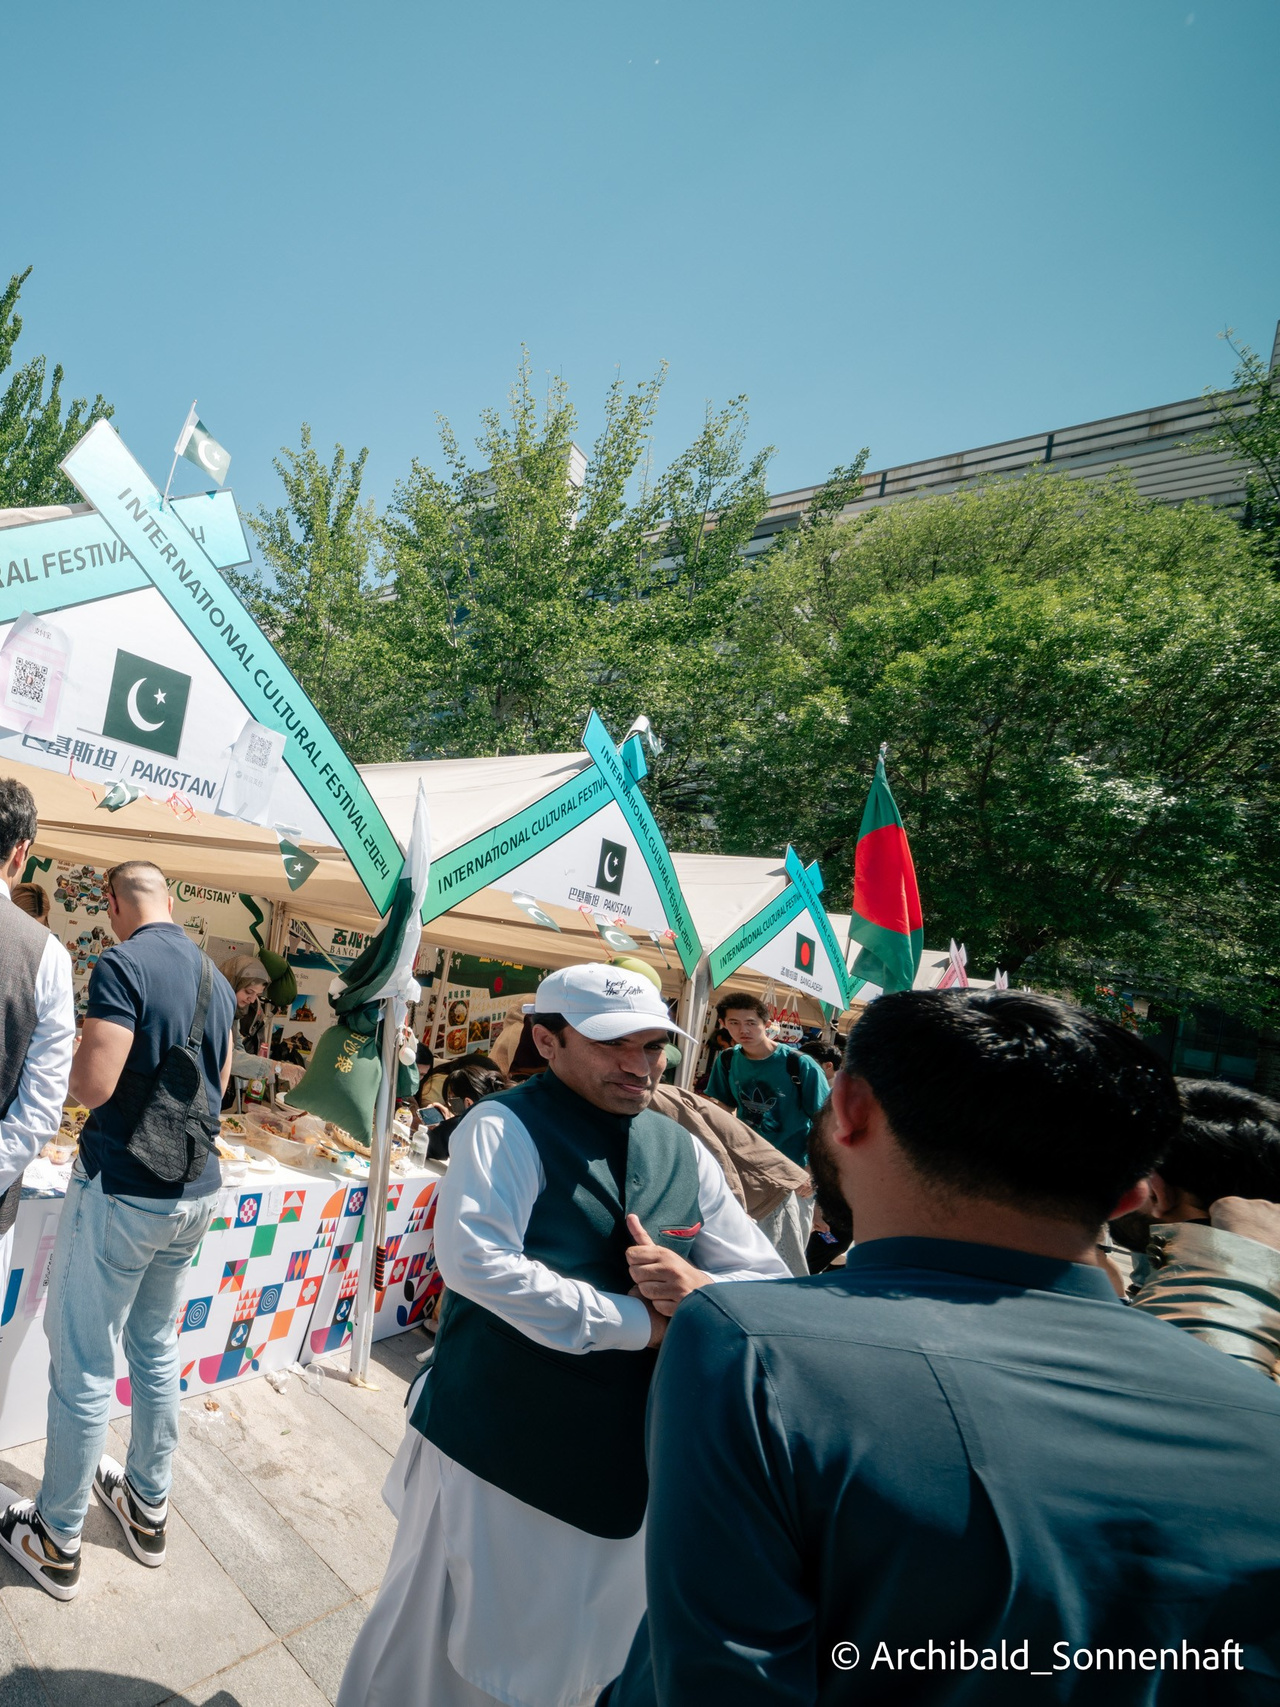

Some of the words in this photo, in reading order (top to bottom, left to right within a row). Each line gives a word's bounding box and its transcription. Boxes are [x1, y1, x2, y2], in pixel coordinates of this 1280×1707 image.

[42, 540, 134, 579] FESTIVA
[117, 487, 254, 672] INTERNATIONAL
[254, 668, 322, 768] CULTURAL
[318, 762, 367, 839] FESTIVAL
[363, 834, 391, 880] 2024
[130, 759, 217, 799] PAKISTAN
[438, 827, 531, 894] INTERNATIONAL
[531, 798, 578, 836] CULTURAL
[578, 776, 608, 806] FESTIVA
[601, 745, 650, 840] INTERNATIONAL
[648, 836, 671, 890] CULTURAL
[669, 887, 684, 933] FESTIVAL
[681, 927, 694, 955] 2024
[184, 884, 231, 904] PAKISTAN
[568, 887, 600, 907] 巴基斯坦
[603, 899, 633, 917] PAKISTAN
[720, 928, 763, 969] INTERNATIONAL
